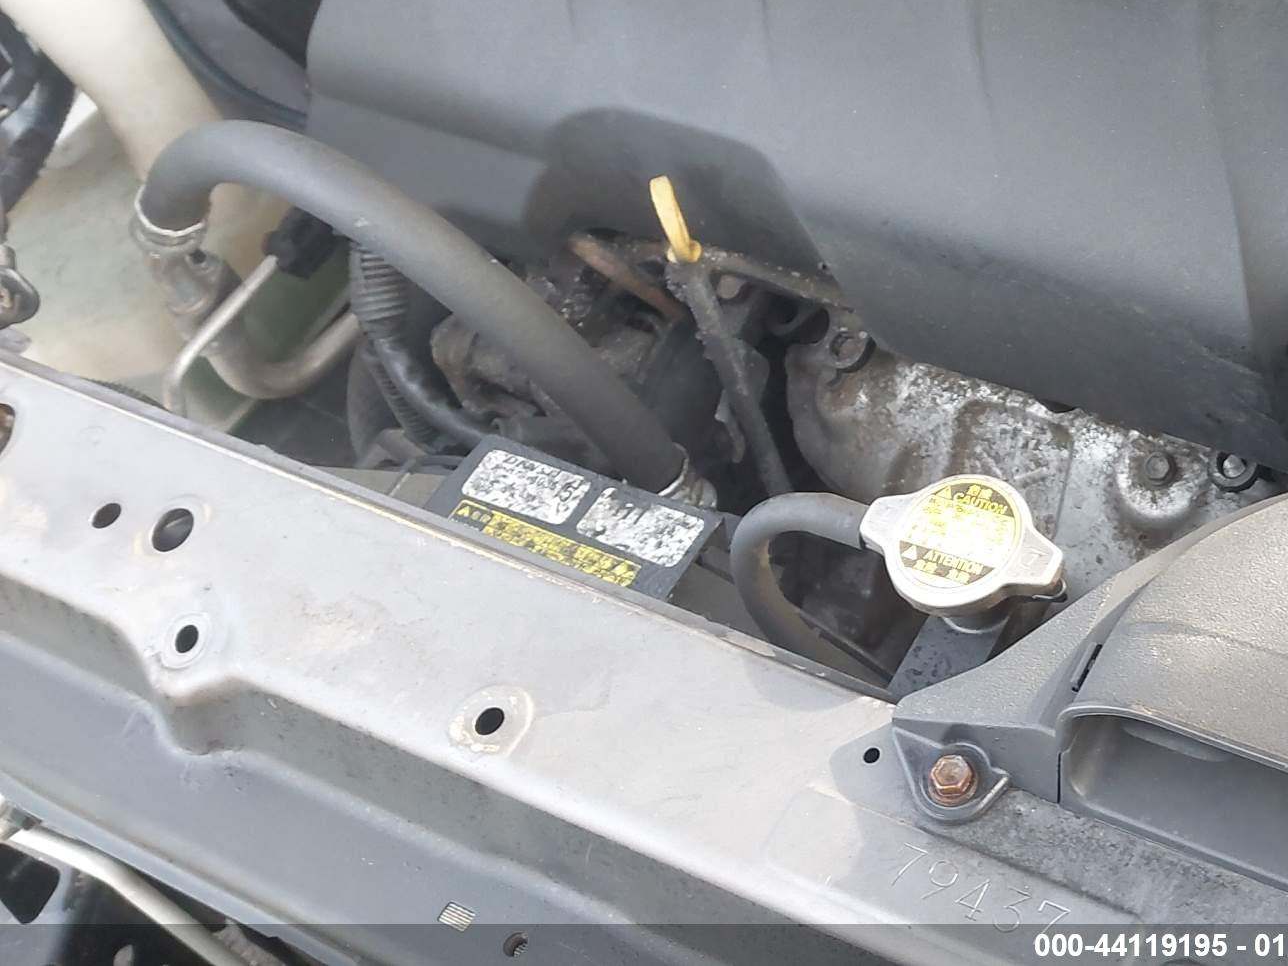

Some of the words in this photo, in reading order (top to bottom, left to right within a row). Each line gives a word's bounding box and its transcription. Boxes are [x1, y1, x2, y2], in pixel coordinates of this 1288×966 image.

[953, 492, 1009, 515] CAUTION
[922, 549, 984, 575] ATTENTION
[890, 842, 1073, 937] 79437
